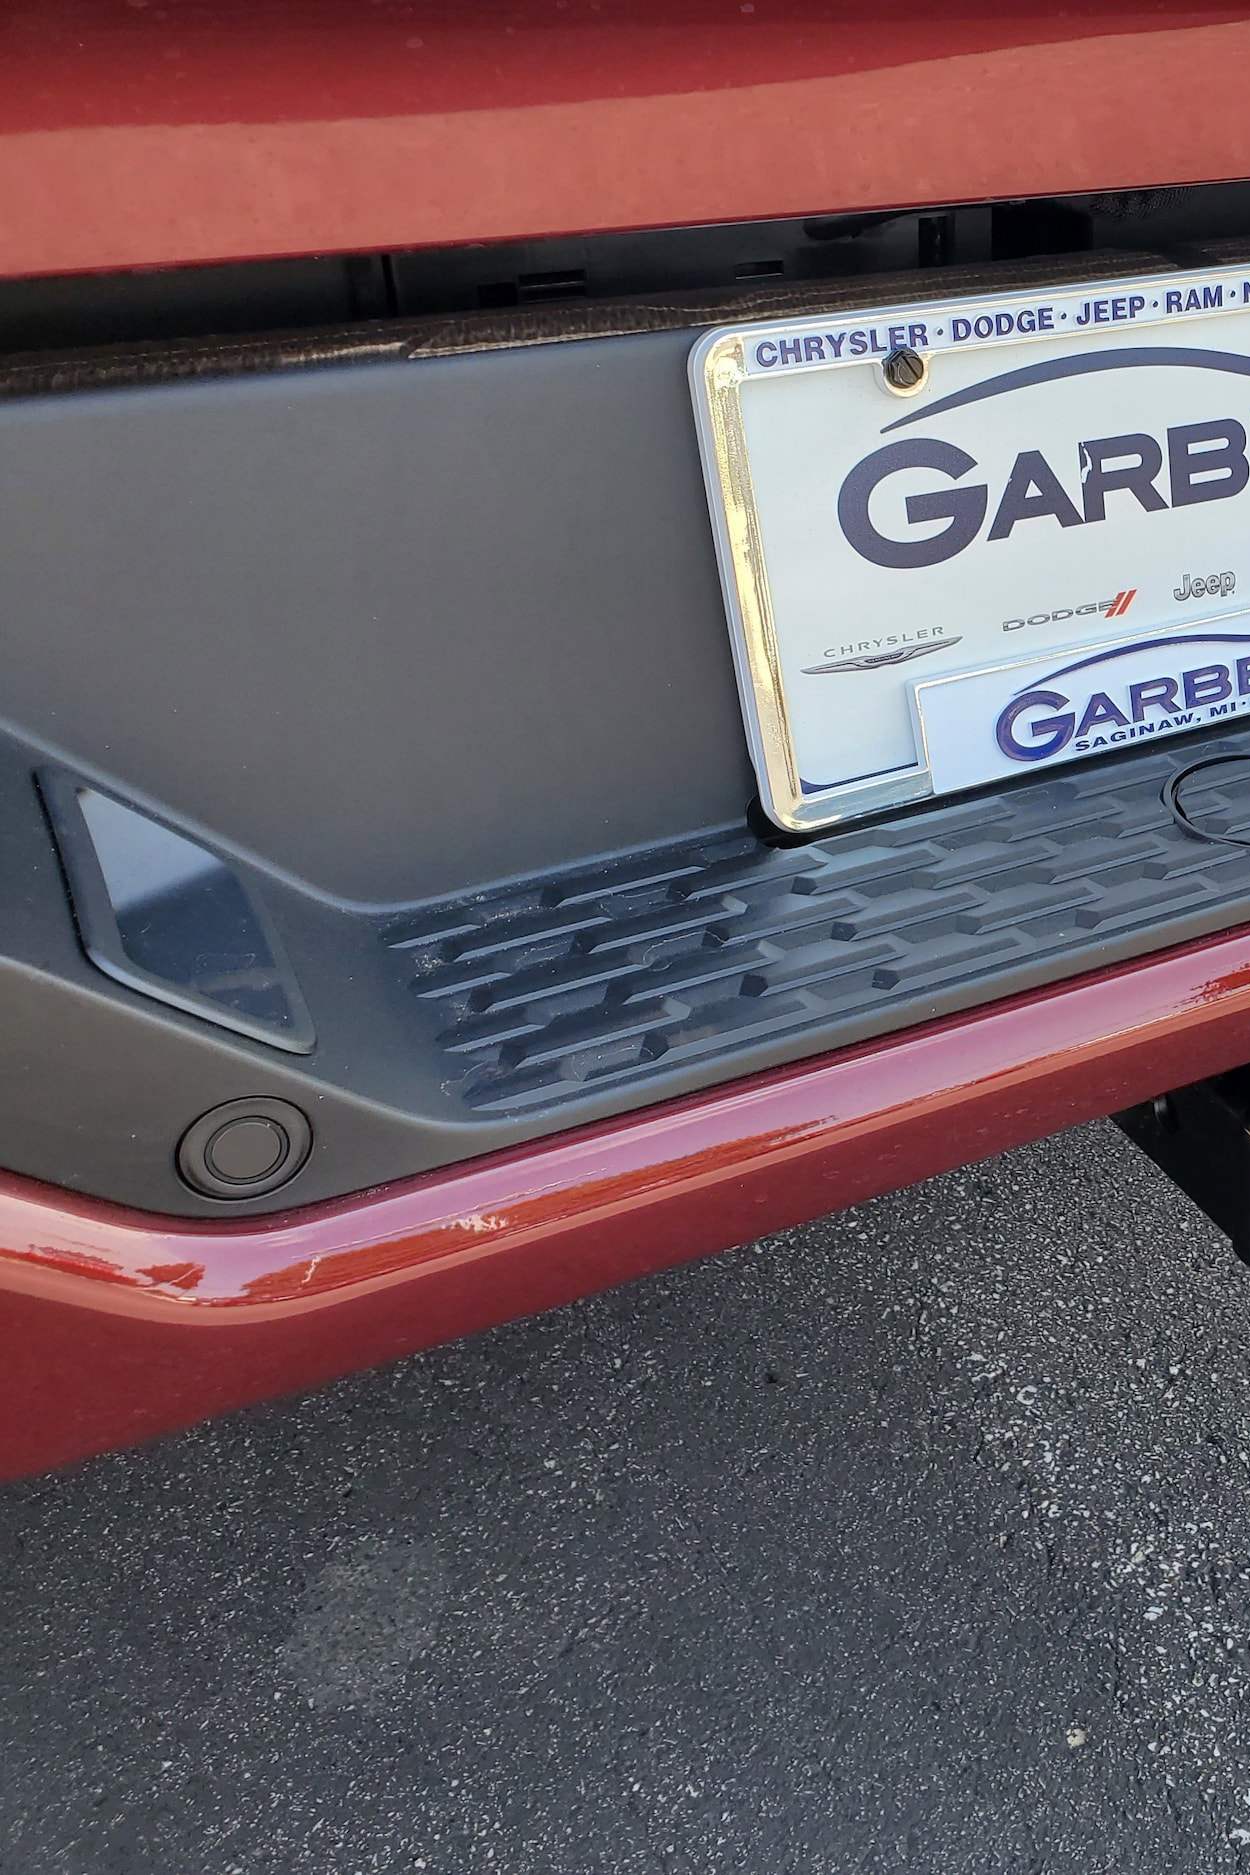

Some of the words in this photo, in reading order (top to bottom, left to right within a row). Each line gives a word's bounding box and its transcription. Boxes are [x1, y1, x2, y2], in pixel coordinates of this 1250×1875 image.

[756, 323, 928, 368] CHRYSLER
[953, 307, 1054, 342] DODGE
[1076, 296, 1145, 326] JEEP
[1166, 285, 1223, 314] RAM
[1173, 571, 1236, 601] Jeep
[1002, 599, 1120, 632] DODGE
[823, 626, 945, 658] CHRYSLER
[1075, 712, 1202, 751] SAGINAW,
[1210, 702, 1237, 718] MI
